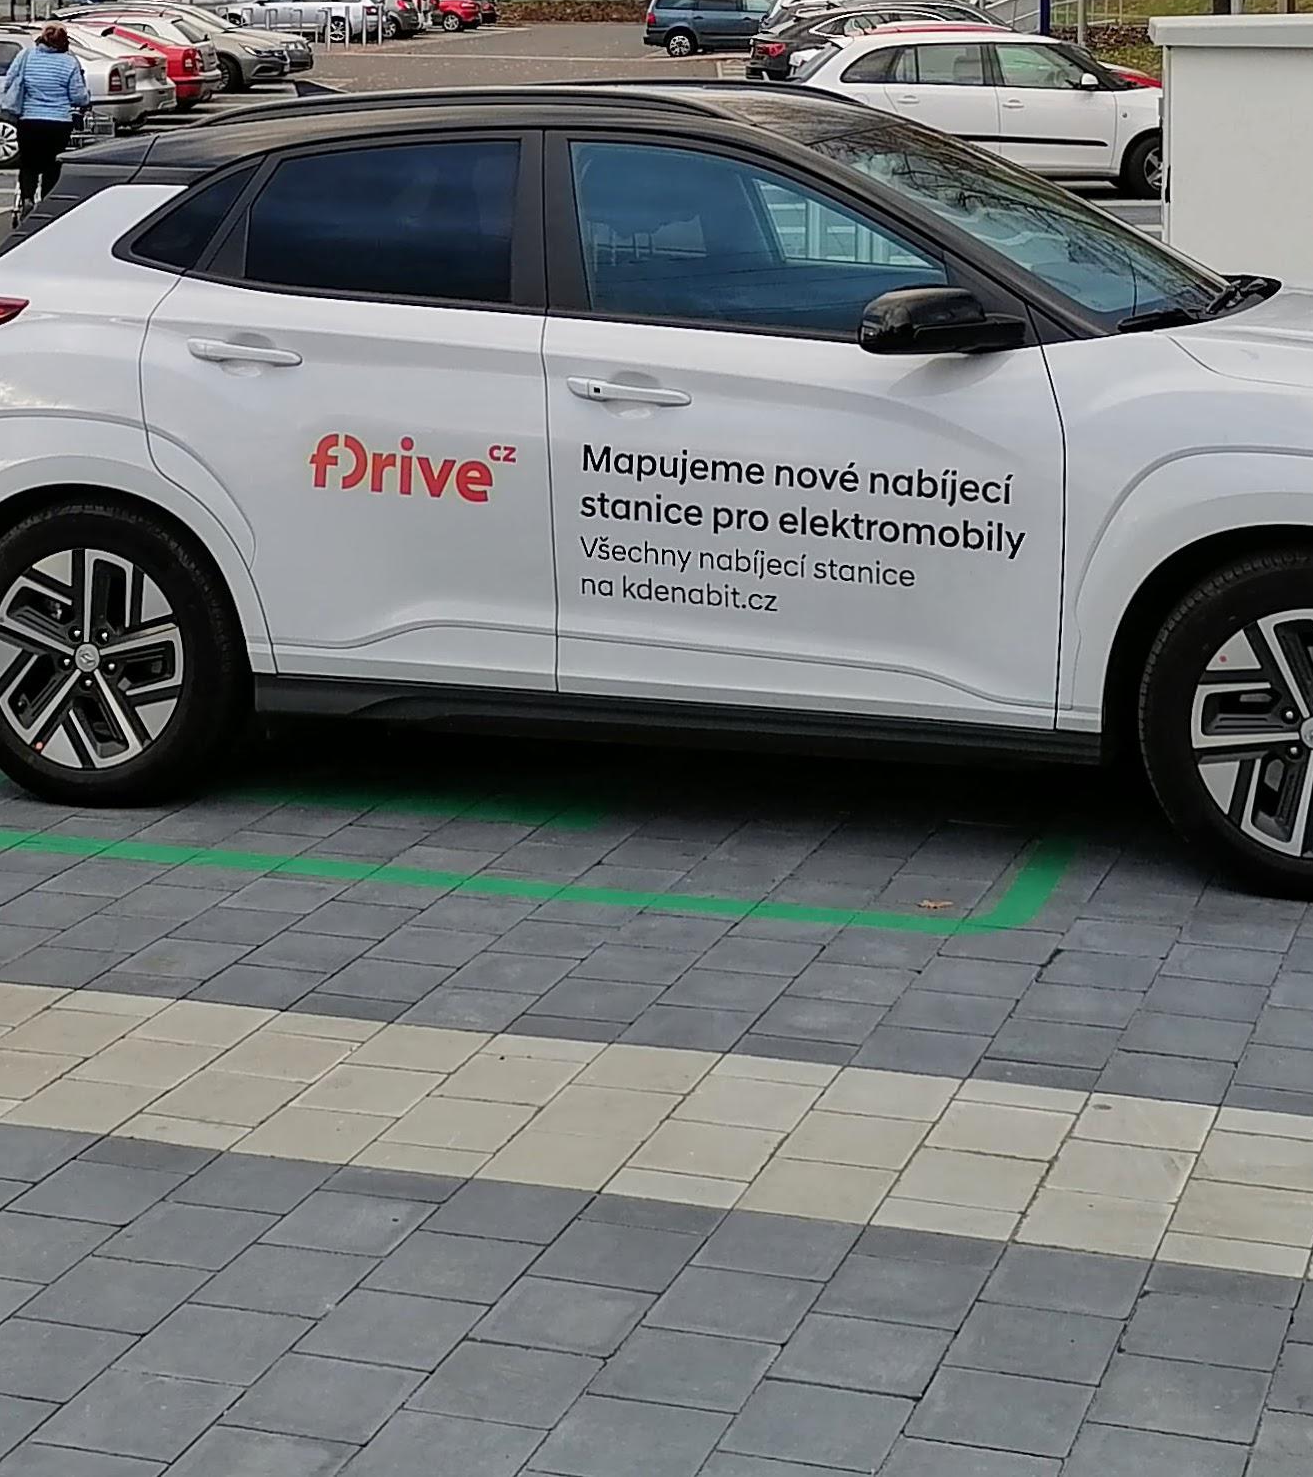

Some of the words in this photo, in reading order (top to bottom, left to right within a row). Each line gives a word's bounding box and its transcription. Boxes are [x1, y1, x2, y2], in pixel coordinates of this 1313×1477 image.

[582, 444, 765, 485] Mapujeme
[775, 462, 860, 493] nové
[869, 468, 1014, 507] nabíjecí
[580, 492, 703, 527] stanice
[713, 507, 770, 535] pro
[779, 507, 1026, 560] elektromobily
[580, 535, 692, 573] Všechny
[699, 548, 806, 580] nabíjecí
[813, 559, 916, 587] stanice
[581, 577, 613, 597] na
[622, 575, 778, 611] kdenabit.cz
